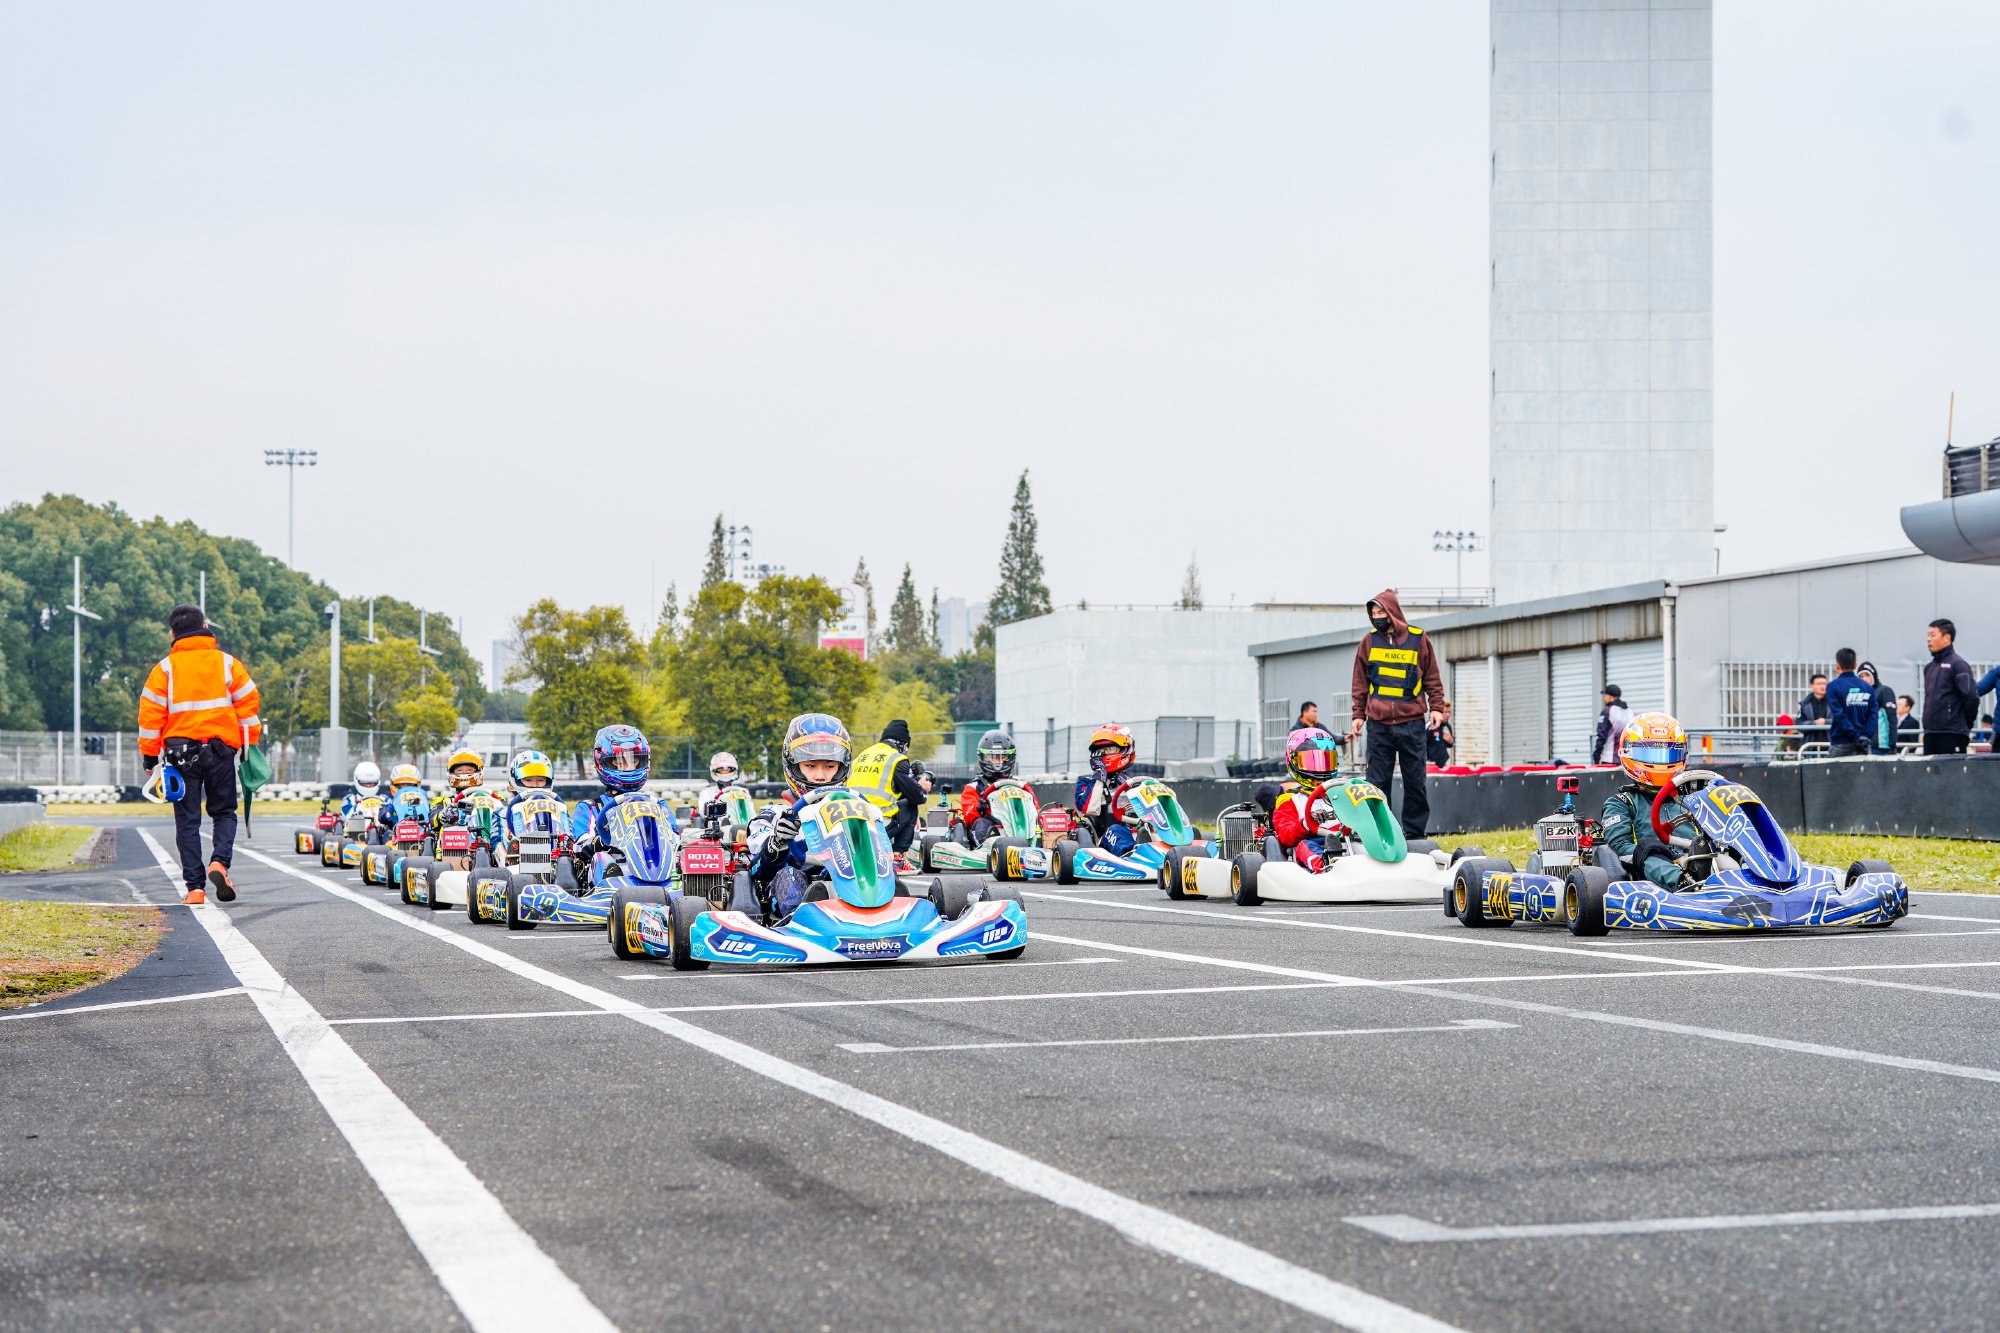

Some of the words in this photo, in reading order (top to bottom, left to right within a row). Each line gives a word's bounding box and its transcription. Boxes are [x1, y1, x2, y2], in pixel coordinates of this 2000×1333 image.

[1384, 652, 1407, 660] RMCC
[526, 802, 558, 816] 266
[826, 800, 872, 824] 214
[847, 941, 901, 951] FreeNova
